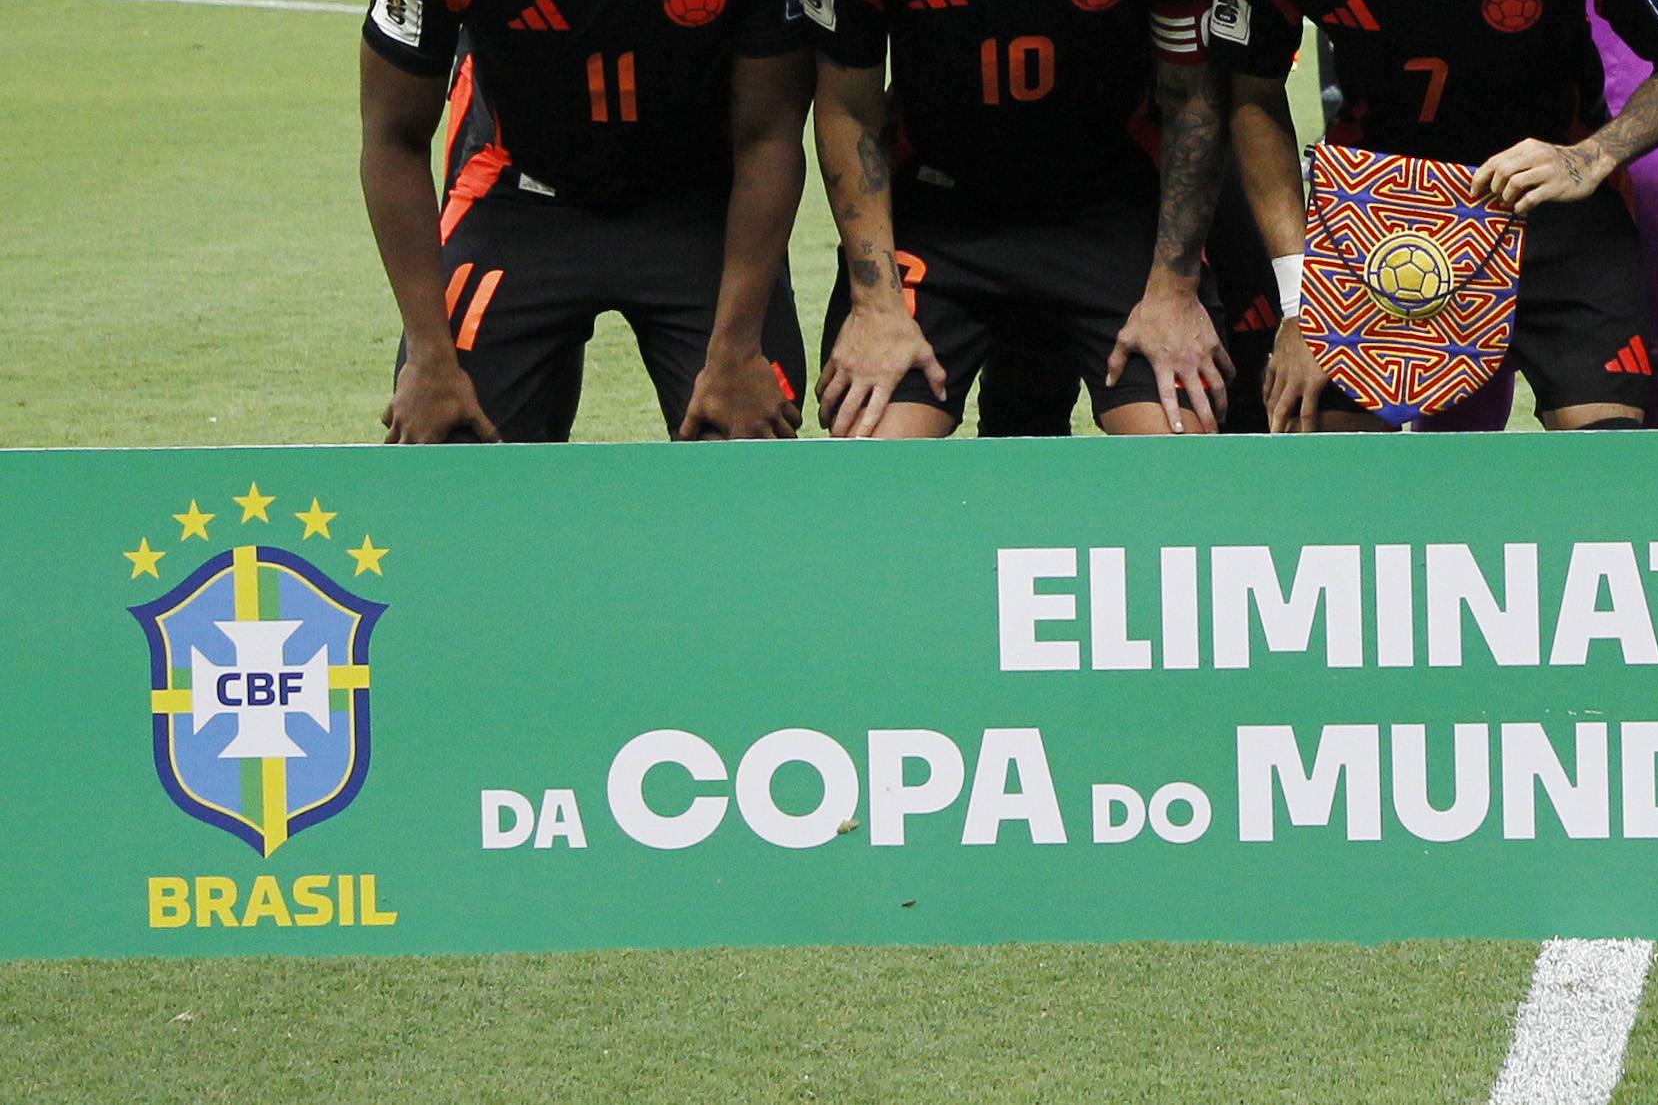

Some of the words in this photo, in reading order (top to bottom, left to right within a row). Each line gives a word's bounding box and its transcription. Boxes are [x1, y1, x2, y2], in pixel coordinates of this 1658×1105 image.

[586, 51, 638, 122] 11
[981, 35, 1055, 106] 10
[1404, 57, 1449, 123] 7
[216, 671, 304, 707] CBF
[481, 789, 588, 849] DA
[607, 728, 1068, 849] COPA
[1092, 782, 1212, 844] DO
[148, 874, 398, 928] BRASIL
